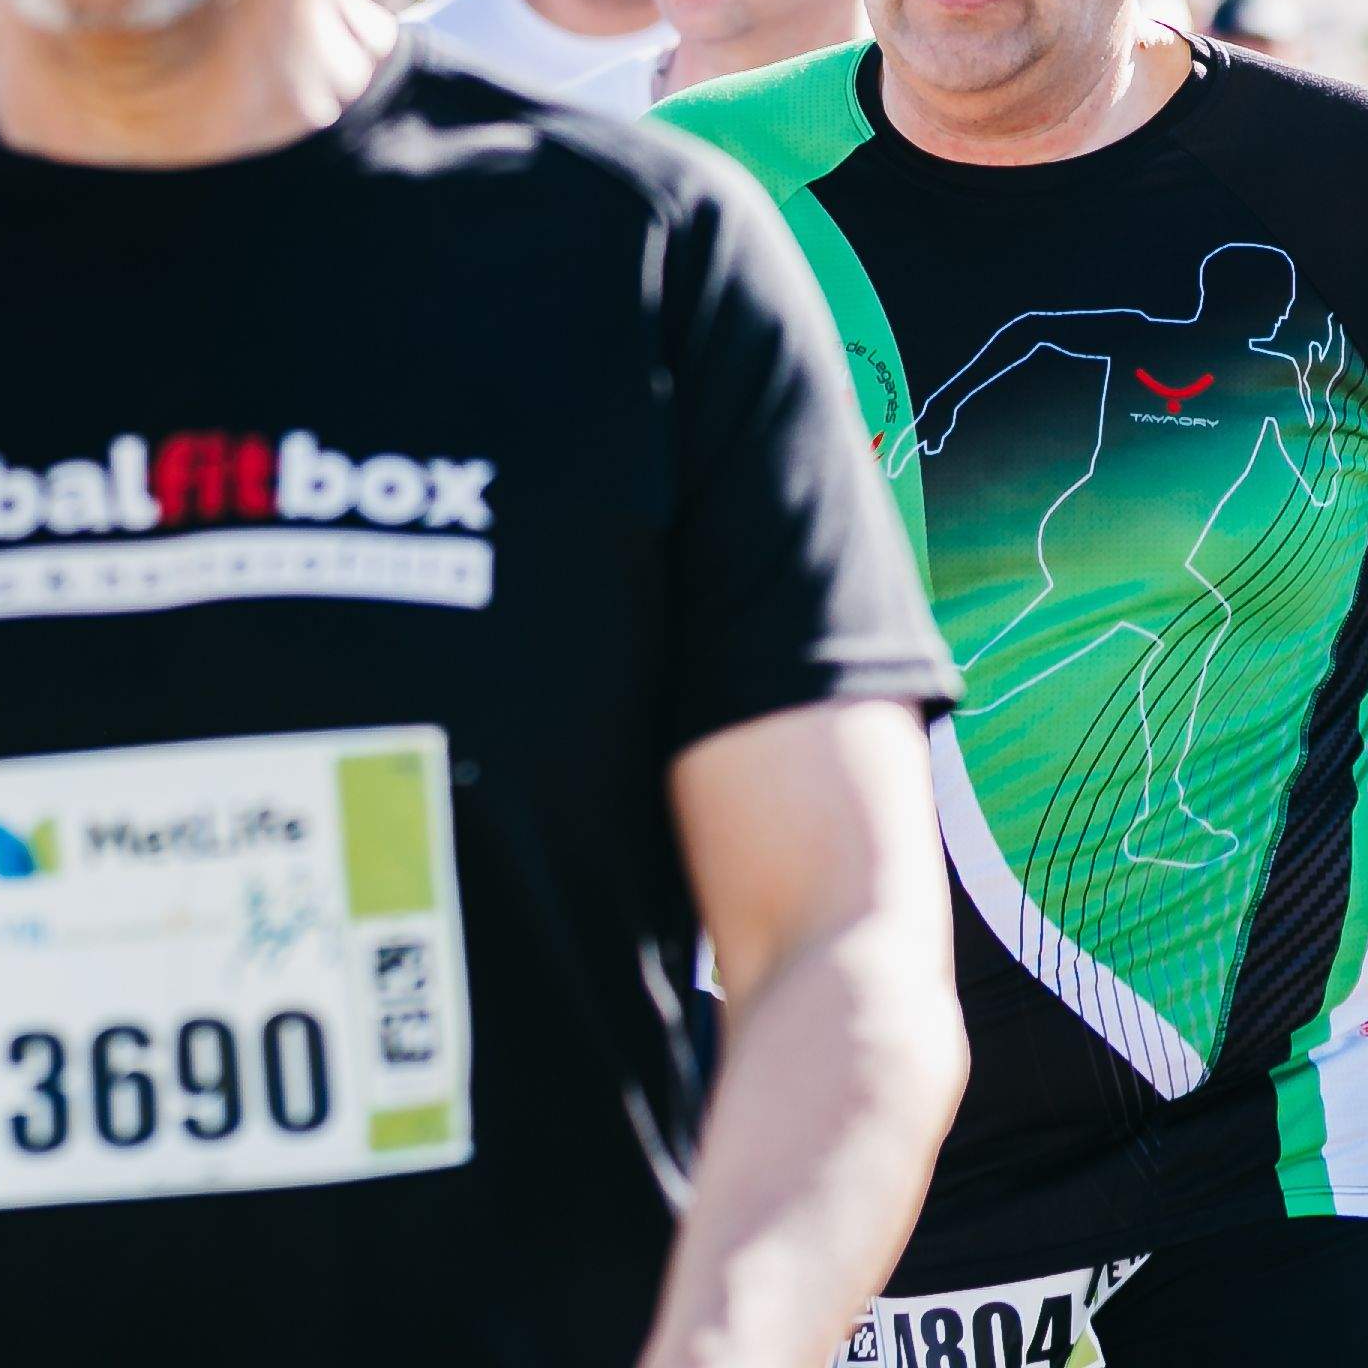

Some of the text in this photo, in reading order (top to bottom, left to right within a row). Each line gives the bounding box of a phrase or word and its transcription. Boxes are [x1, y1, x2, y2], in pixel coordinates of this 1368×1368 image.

[845, 338, 867, 358] de
[1130, 413, 1220, 428] TAYMORY
[7, 1007, 331, 1155] 3690
